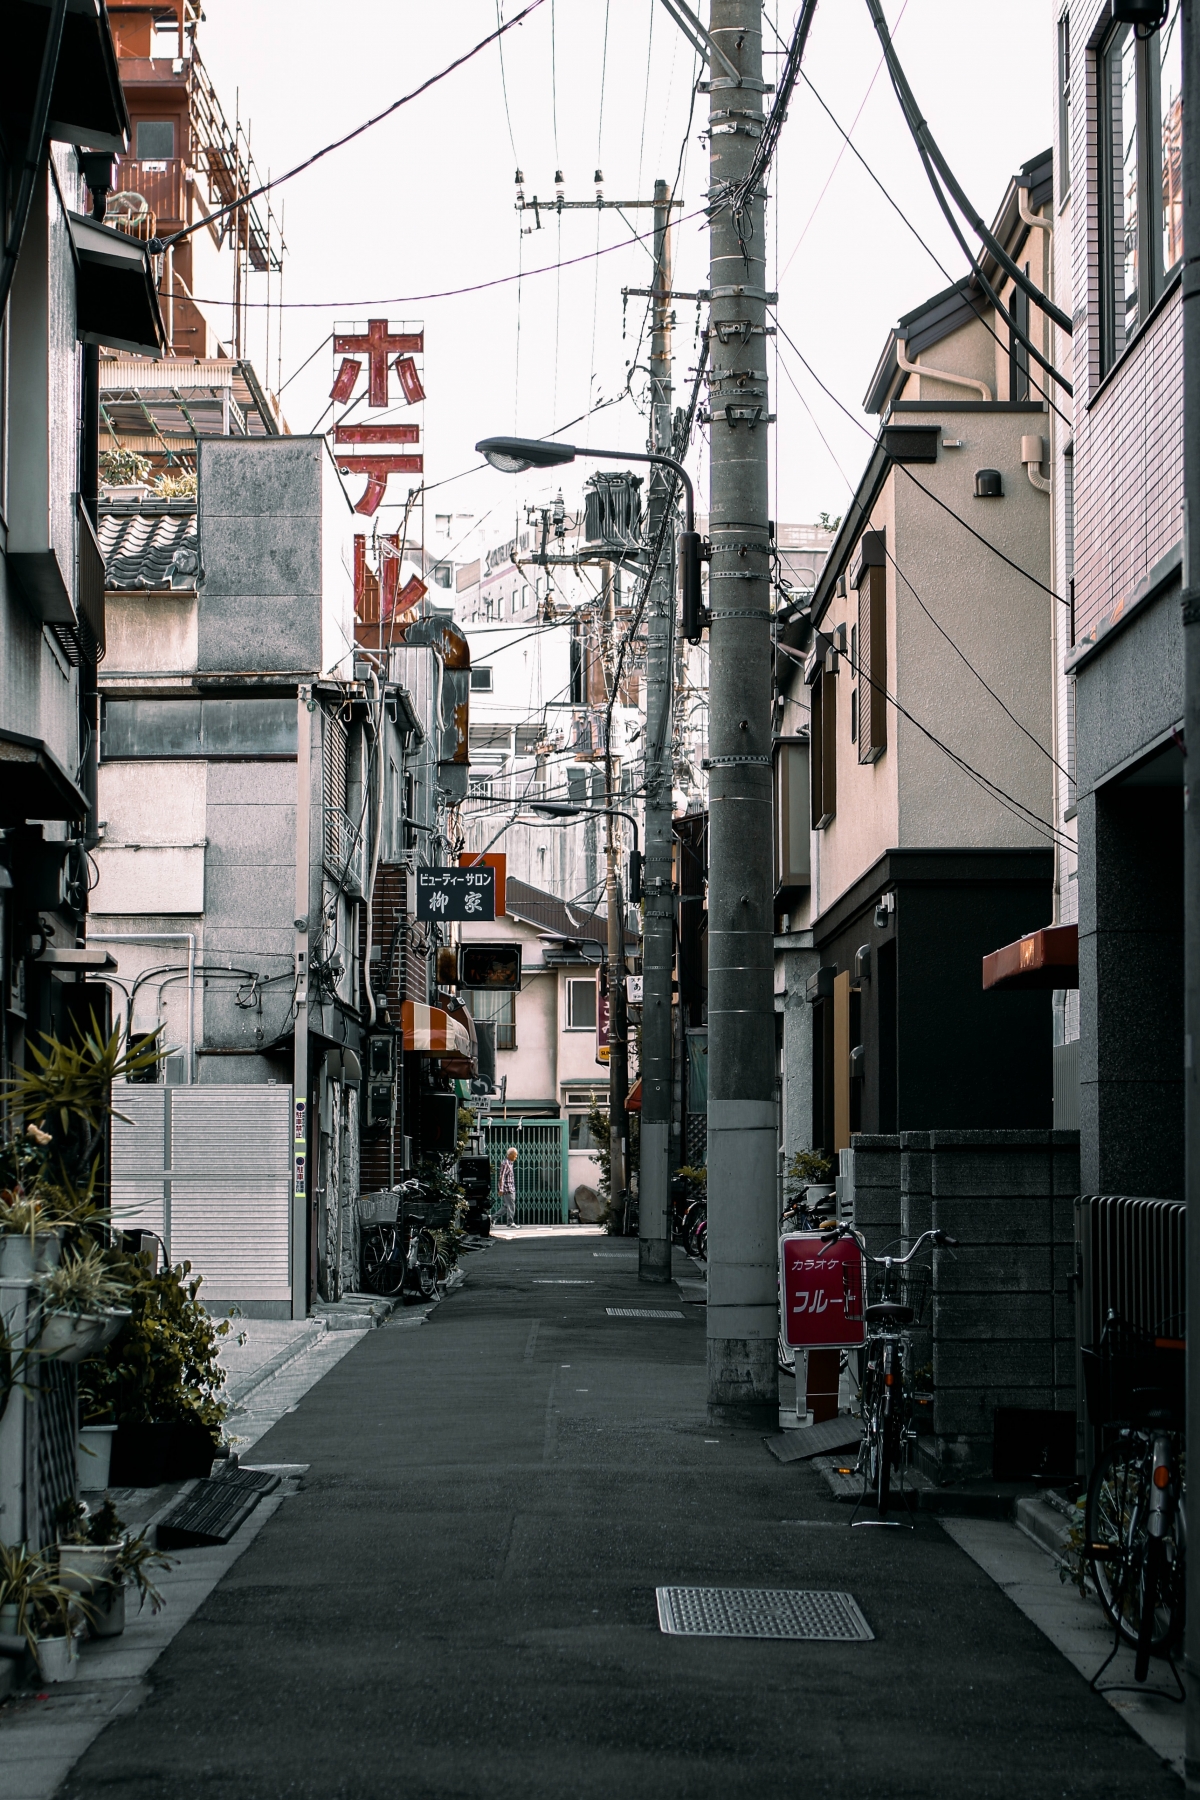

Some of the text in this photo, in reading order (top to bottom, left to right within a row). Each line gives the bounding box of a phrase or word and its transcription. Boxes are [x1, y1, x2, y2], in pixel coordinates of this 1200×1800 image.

[329, 319, 428, 624] ホテル
[420, 873, 491, 886] ビューティーサロン
[429, 890, 483, 914] 柳家
[791, 1259, 839, 1271] カラオケ
[793, 1289, 856, 1313] フルート
